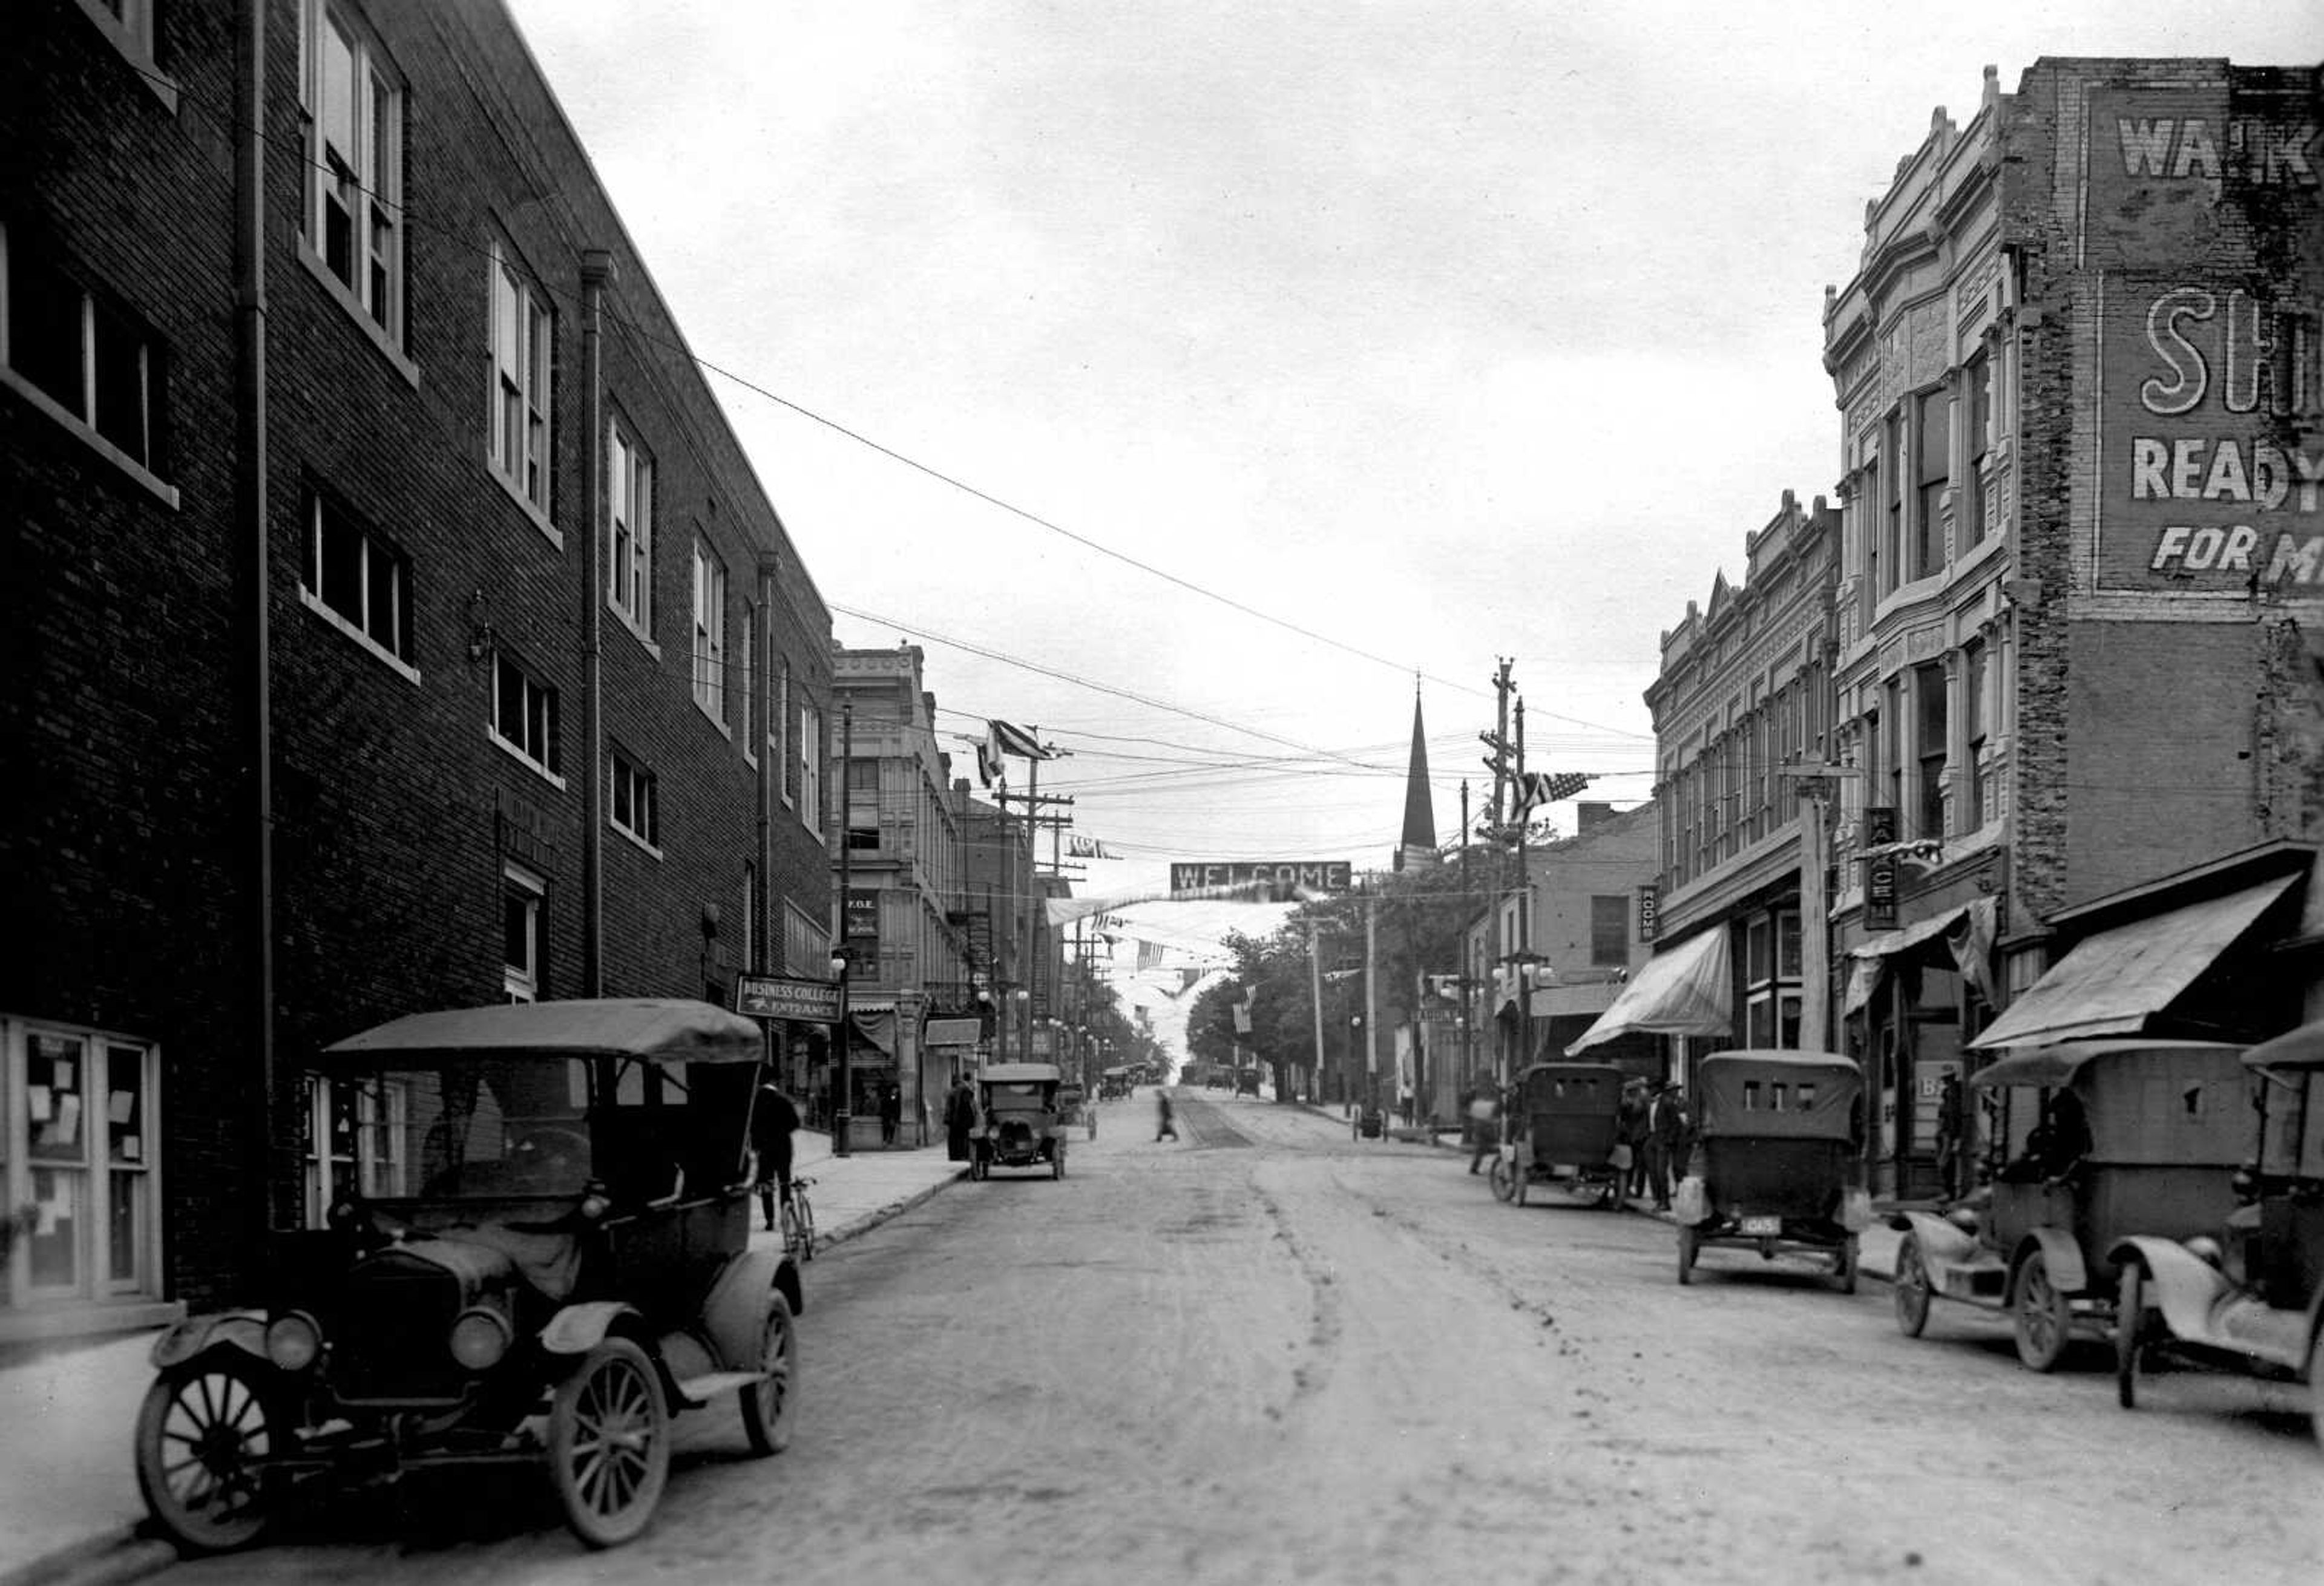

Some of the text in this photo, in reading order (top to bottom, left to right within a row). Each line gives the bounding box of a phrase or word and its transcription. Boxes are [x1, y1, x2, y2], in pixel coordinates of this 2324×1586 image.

[2141, 285, 2324, 416] SH
[2133, 436, 2324, 513] READY
[2150, 525, 2324, 584] FOR M
[1177, 863, 1346, 889] WELCOME
[744, 980, 838, 1003] BUSINESS COLLEGE
[772, 1001, 835, 1016] ENTRANCE
